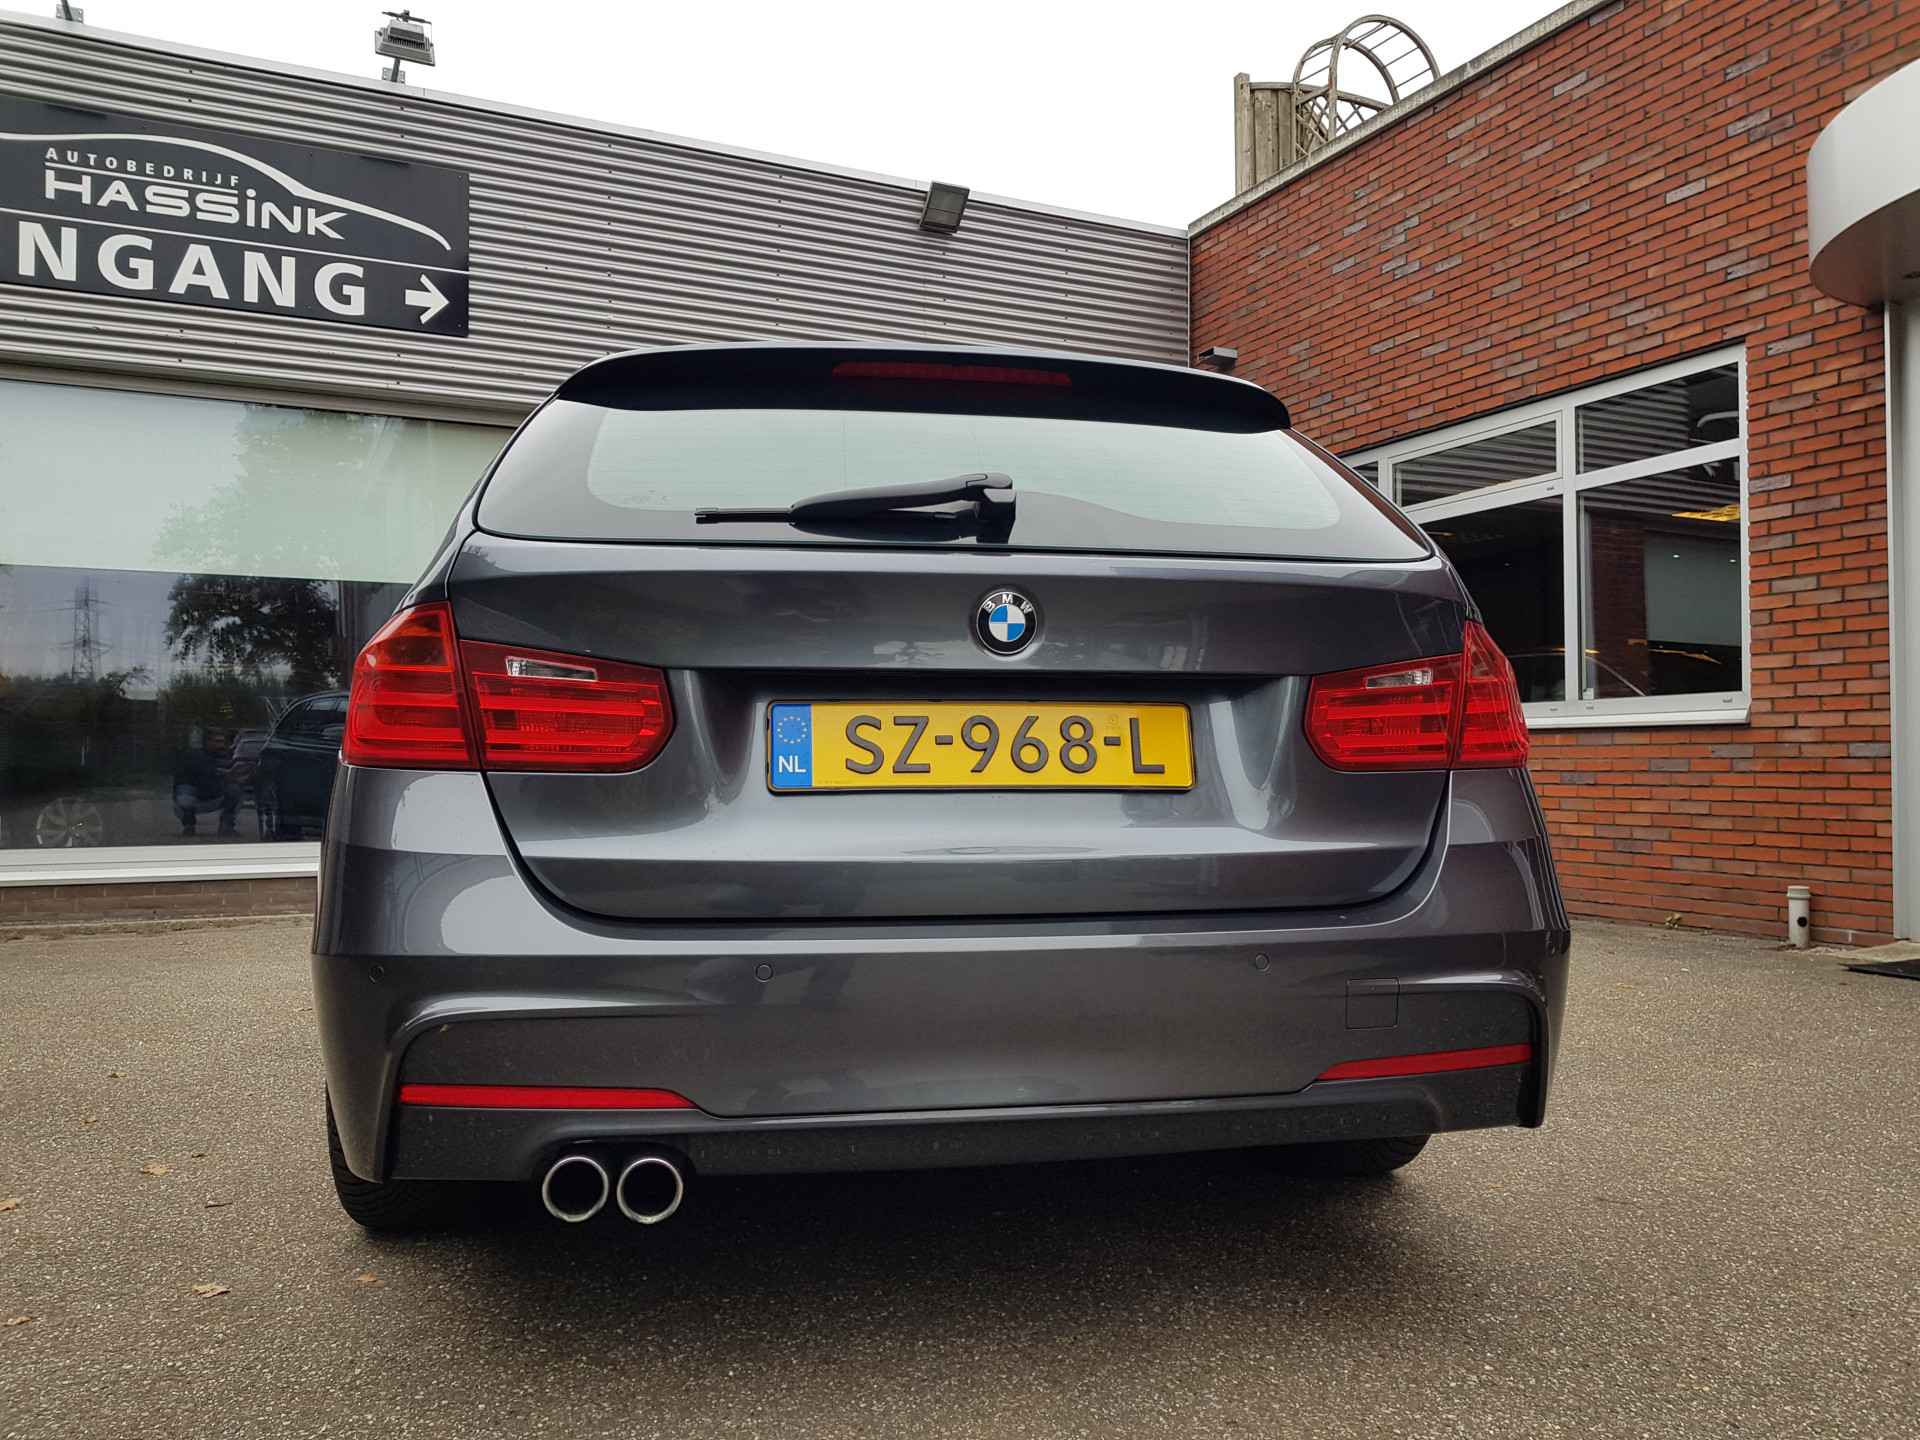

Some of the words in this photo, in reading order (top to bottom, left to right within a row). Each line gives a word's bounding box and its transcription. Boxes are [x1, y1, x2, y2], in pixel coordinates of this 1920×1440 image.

[46, 147, 239, 187] AUTOBEDRIJF
[18, 221, 366, 316] NGANG
[983, 594, 1033, 613] BMW
[778, 755, 806, 773] NL
[845, 715, 1165, 774] SZ-968-L
